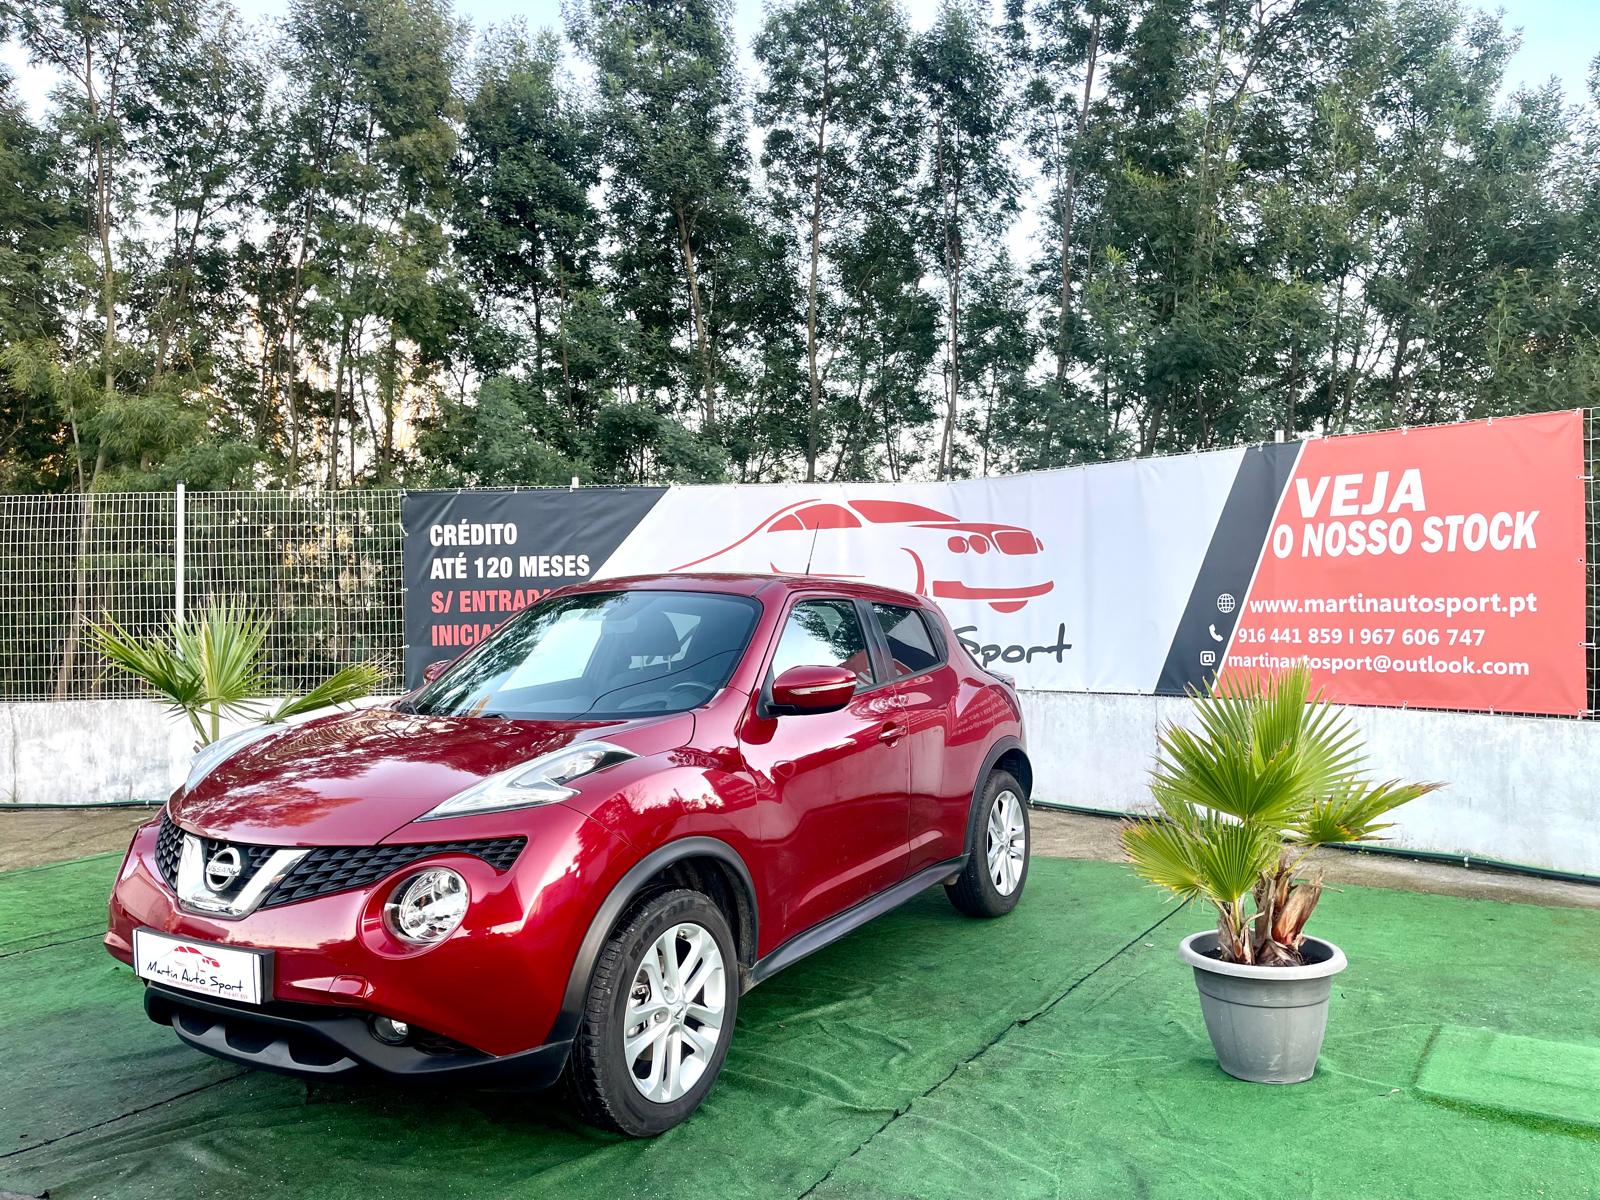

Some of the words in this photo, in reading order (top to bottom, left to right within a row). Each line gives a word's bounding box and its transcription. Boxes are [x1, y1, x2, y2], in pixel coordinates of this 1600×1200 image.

[1295, 468, 1426, 518] VEJA
[430, 519, 518, 546] CRÉDITO
[1273, 524, 1294, 558] O
[1301, 517, 1413, 557] NOSSO
[1420, 510, 1540, 553] STOCK
[430, 552, 467, 579] ATÉ
[474, 557, 513, 578] 120
[519, 555, 590, 577] MESES
[431, 590, 452, 613] S/
[1249, 592, 1537, 618] www.martinautosport.pt
[431, 623, 500, 646] INICIA
[953, 622, 1072, 668] Sport
[1238, 628, 1266, 644] 916
[1270, 628, 1302, 644] 441
[1308, 628, 1342, 645] 859
[1360, 628, 1396, 645] 967
[1402, 628, 1440, 645] 606
[1446, 629, 1486, 646] 747
[147, 961, 178, 978] Martin
[180, 968, 206, 985] Auto
[210, 976, 244, 994] Sport
